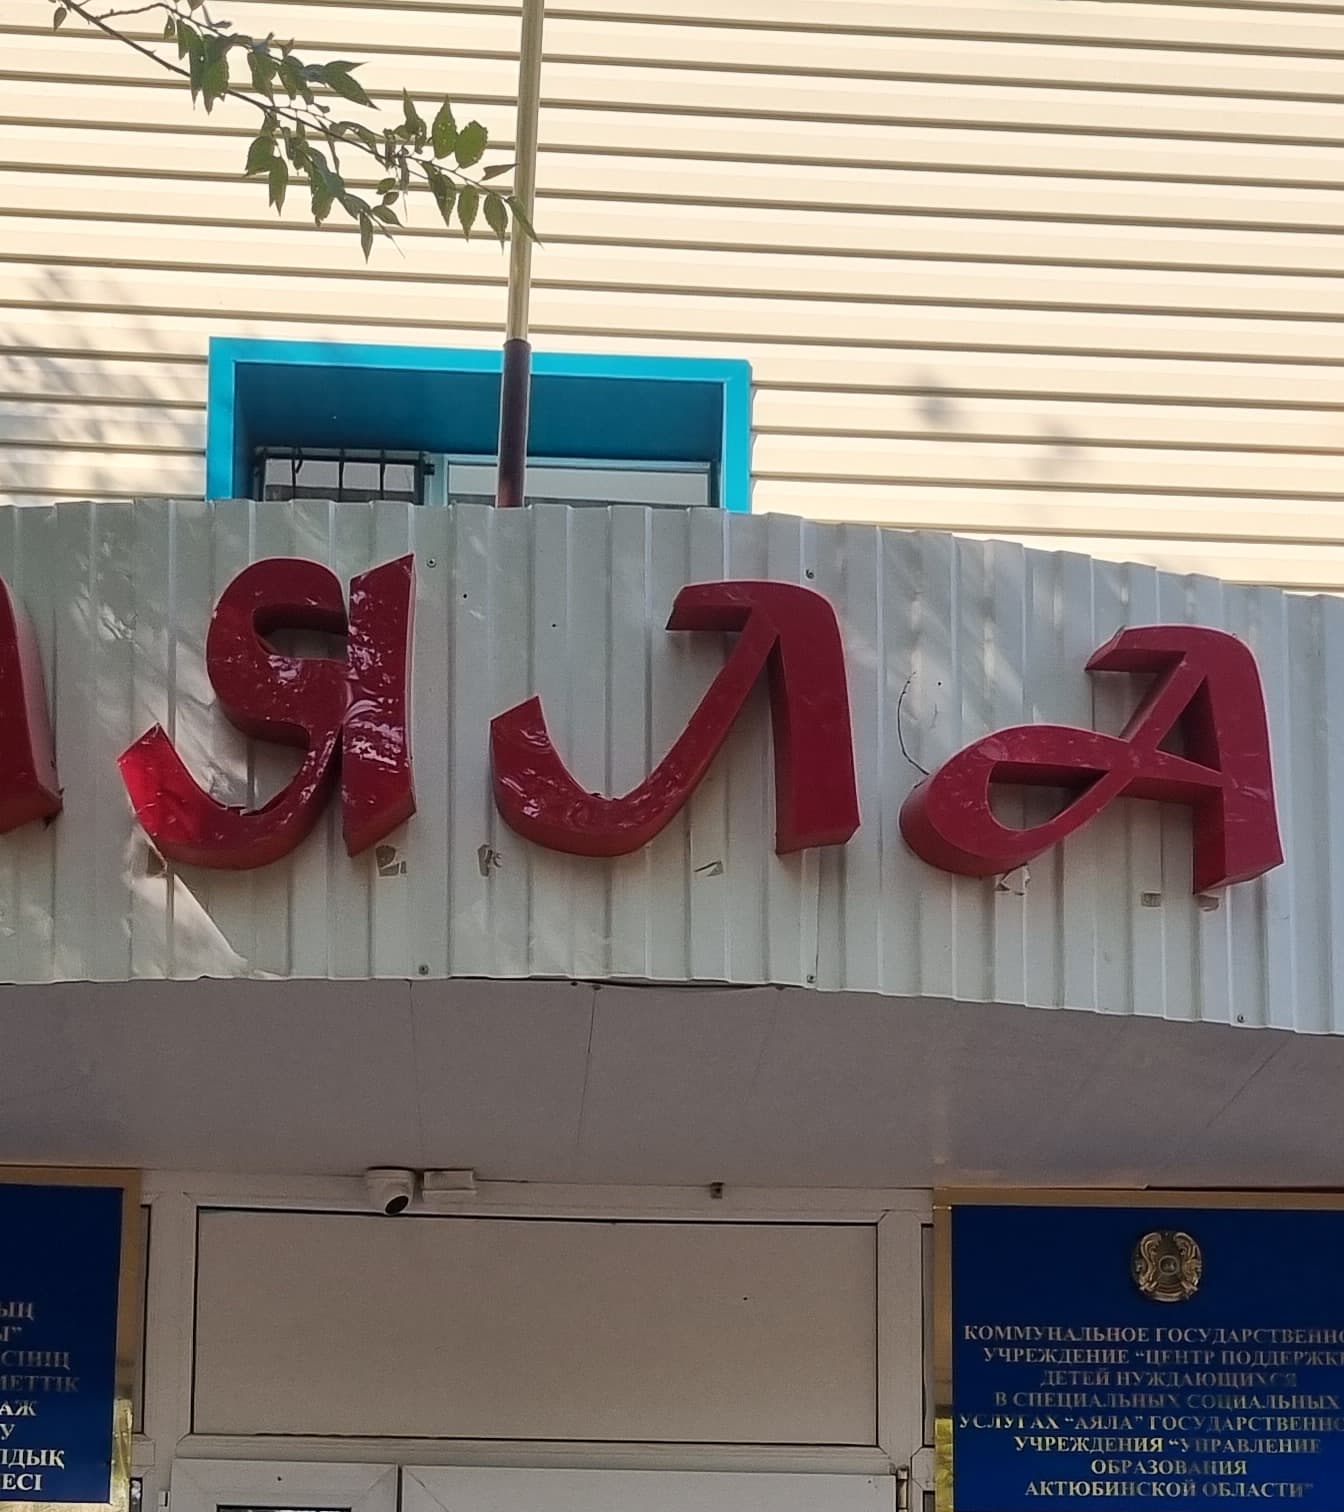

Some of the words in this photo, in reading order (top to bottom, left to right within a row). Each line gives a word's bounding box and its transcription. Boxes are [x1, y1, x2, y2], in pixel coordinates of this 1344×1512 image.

[963, 1324, 1150, 1343] КОММУНАЛЬНОЕ
[983, 1347, 1130, 1365] УЧРЕЖДЕНИЕ
[1040, 1367, 1110, 1387] ДЕТЕЙ
[1116, 1371, 1297, 1389] НУЖДАЮЩИХСЯ
[995, 1392, 1008, 1407] В
[1012, 1392, 1181, 1410] СПЕЦИАЛЬНЫХ
[1187, 1394, 1342, 1413] СОЦИАЛЬНЫХ
[959, 1414, 1060, 1431] УСЛУГАХ
[1013, 1436, 1164, 1454] УЧРЕЖДЕНИЯ
[1090, 1458, 1247, 1476] ОБРАЗОВАНИЯ
[1024, 1479, 1196, 1497] АКТЮБИНСКОЙ
